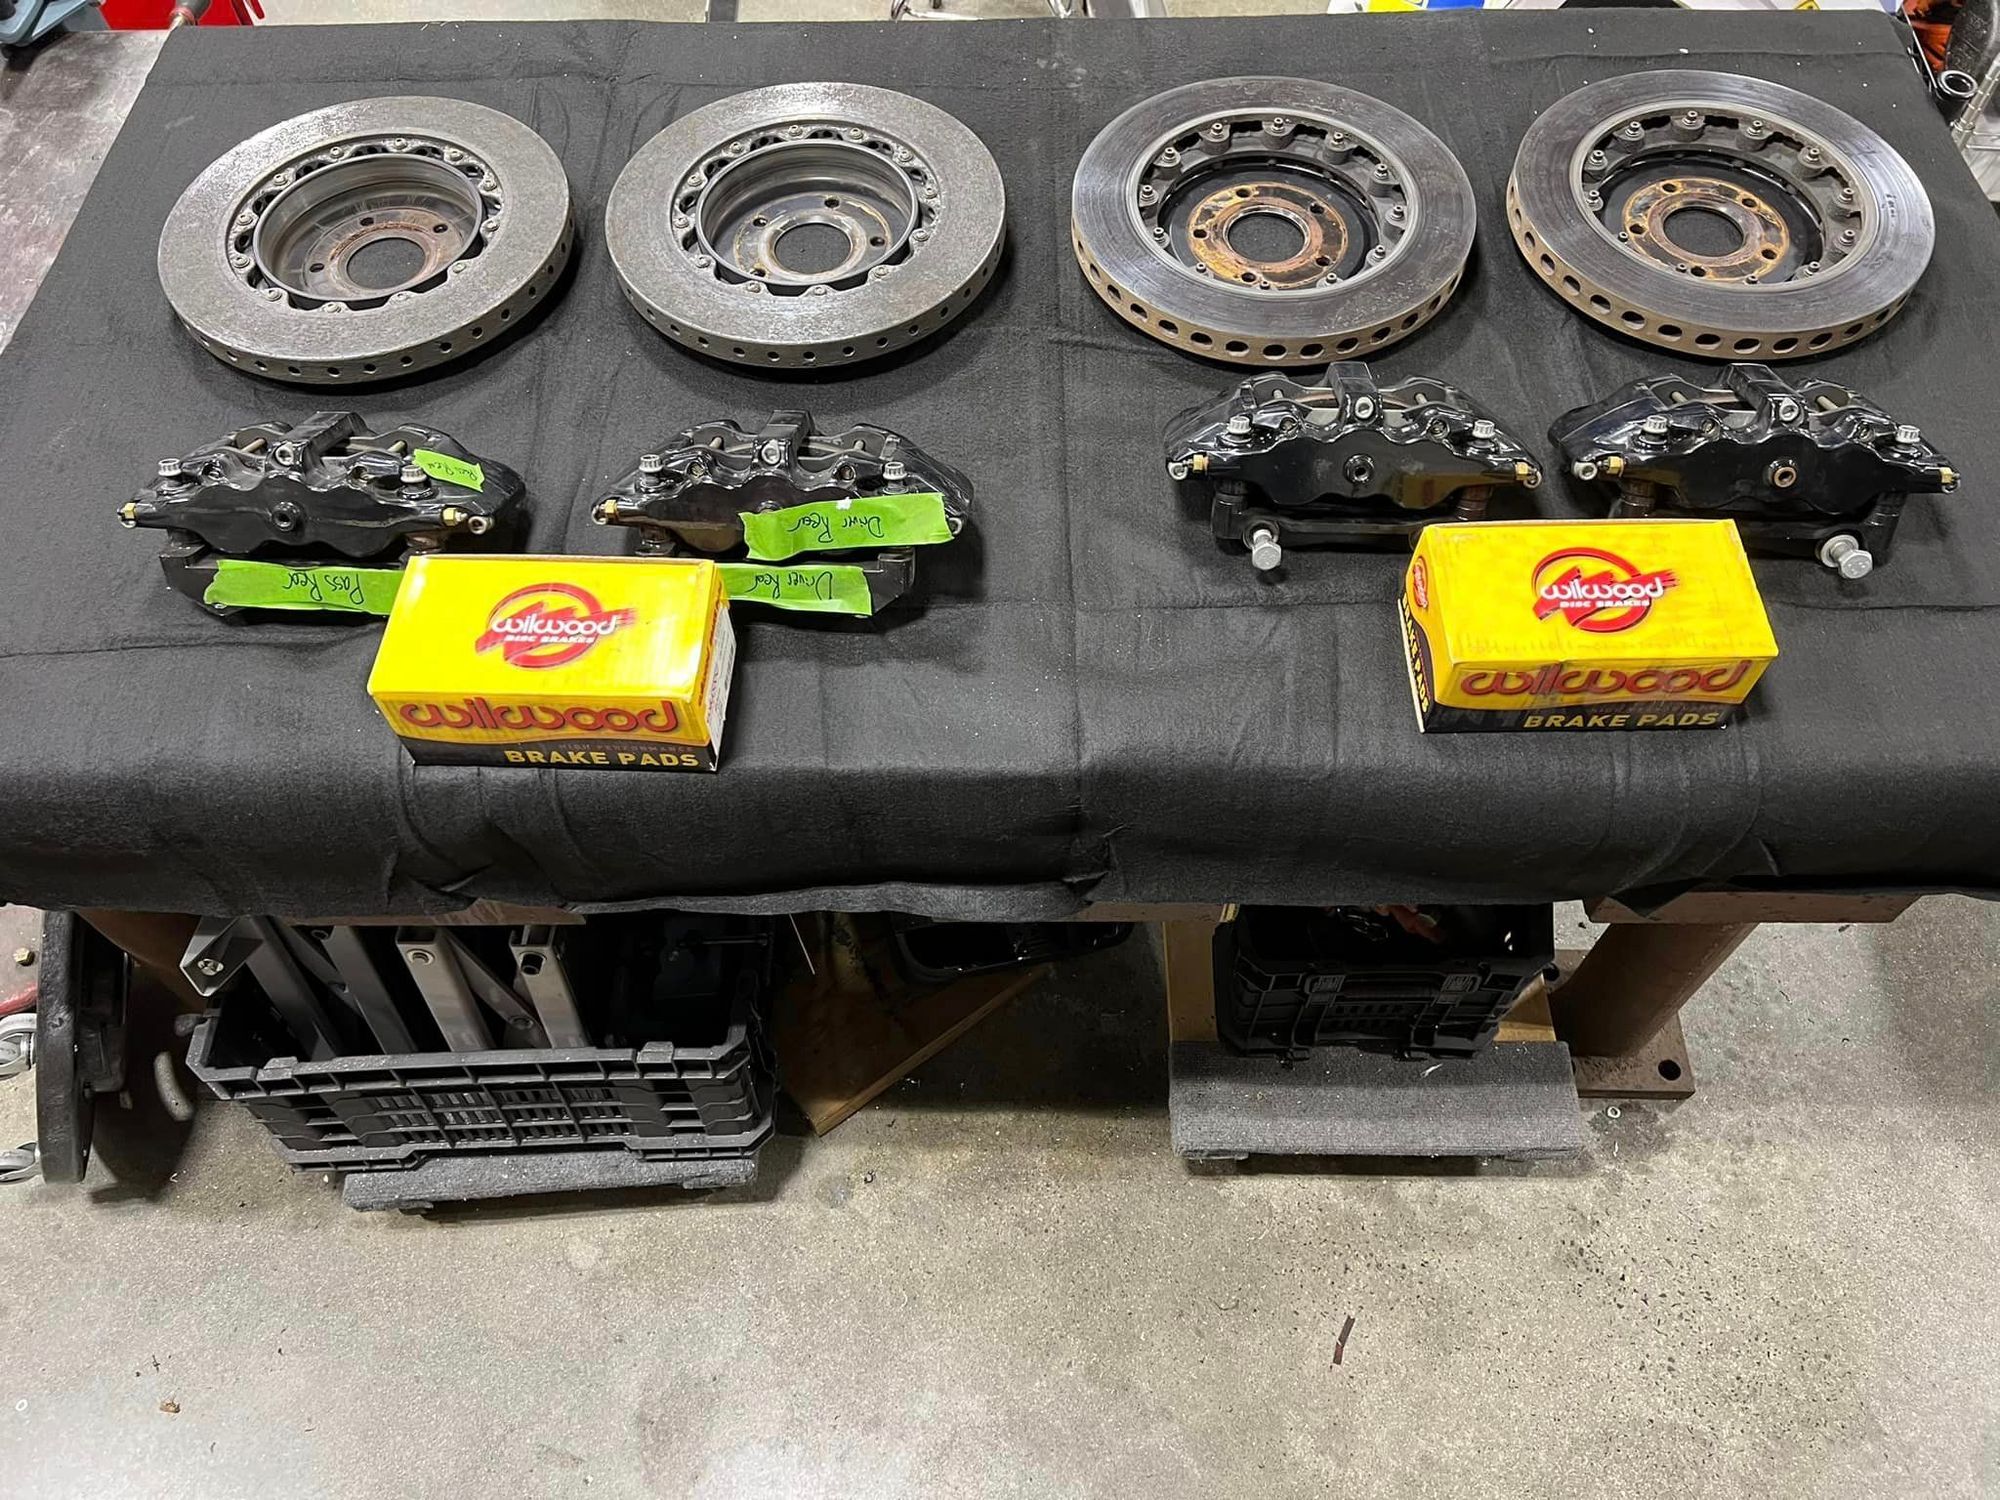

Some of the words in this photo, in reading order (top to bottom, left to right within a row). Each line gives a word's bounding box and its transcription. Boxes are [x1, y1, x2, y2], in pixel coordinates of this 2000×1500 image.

[787, 512, 834, 544] Rear
[841, 515, 885, 539] Driver
[281, 571, 323, 602] Rear
[323, 572, 366, 606] Pass
[744, 573, 780, 600] Rear
[787, 571, 833, 601] Driver
[1540, 576, 1664, 601] wilwood
[1559, 599, 1591, 608] DISC
[1595, 599, 1651, 609] BRAKES
[491, 613, 620, 635] wilwood
[503, 633, 537, 643] DISC
[540, 635, 596, 645] BRAKES
[1460, 660, 1752, 697] wilwood
[399, 698, 678, 732] wilwood
[1523, 714, 1631, 728] BRAKE
[1636, 711, 1720, 727] PADS
[505, 750, 610, 765] BRAKE
[617, 752, 700, 767] PADS
